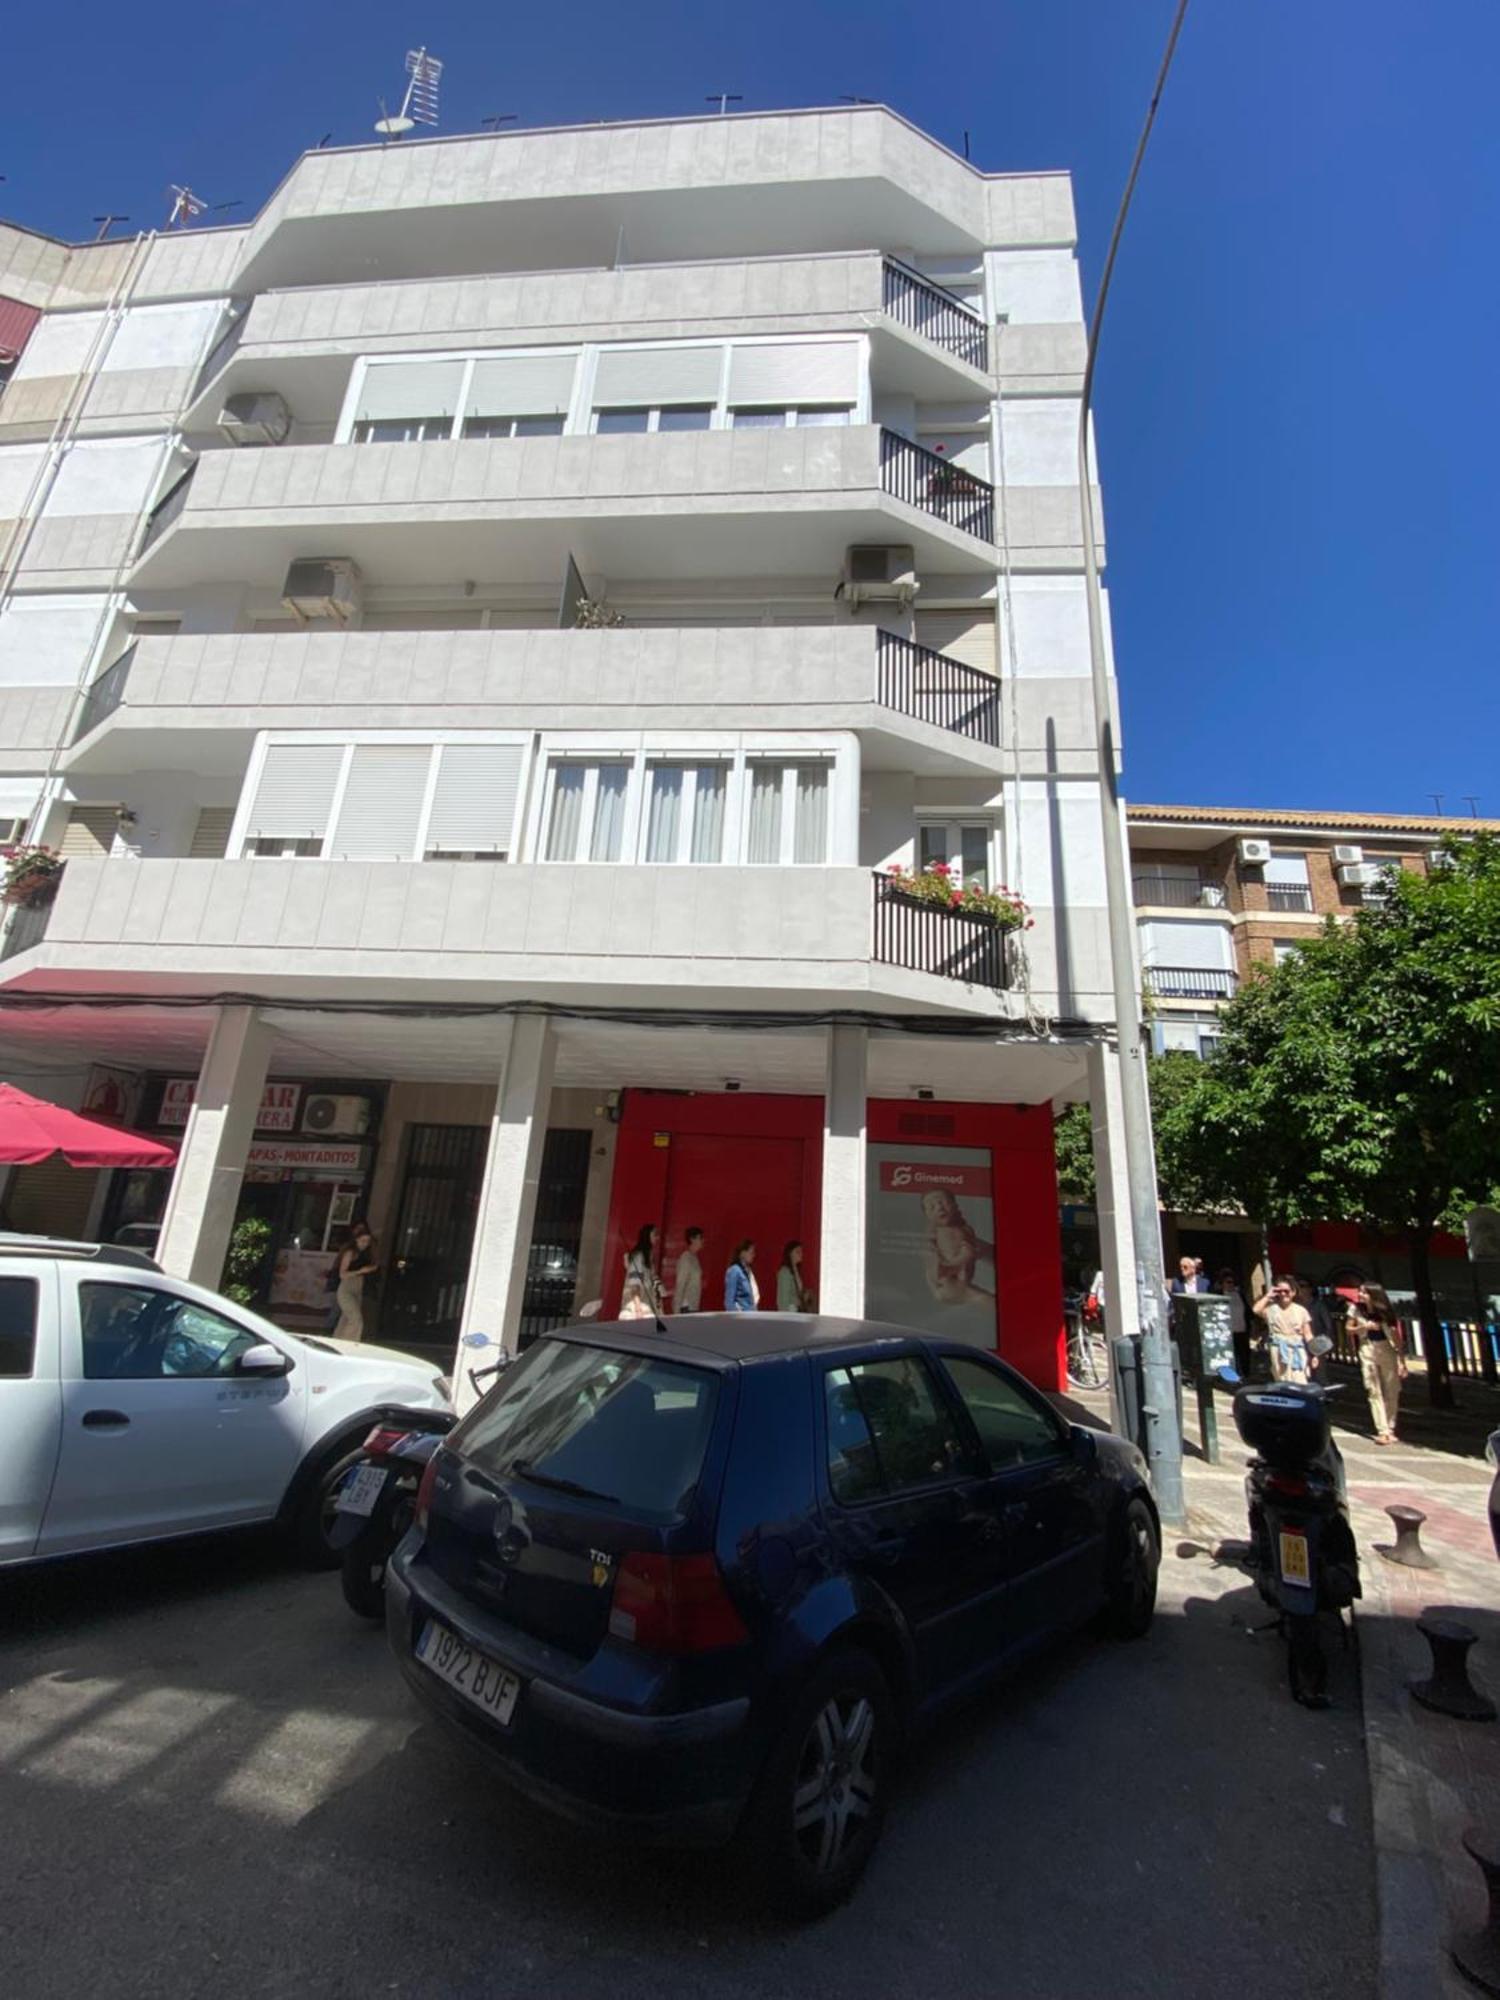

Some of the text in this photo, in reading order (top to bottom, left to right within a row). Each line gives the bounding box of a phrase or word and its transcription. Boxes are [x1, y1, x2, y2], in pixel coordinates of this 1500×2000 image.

[914, 1171, 964, 1186] Ginemed
[590, 1548, 612, 1566] TDI
[432, 1631, 516, 1710] 1972 BJF
